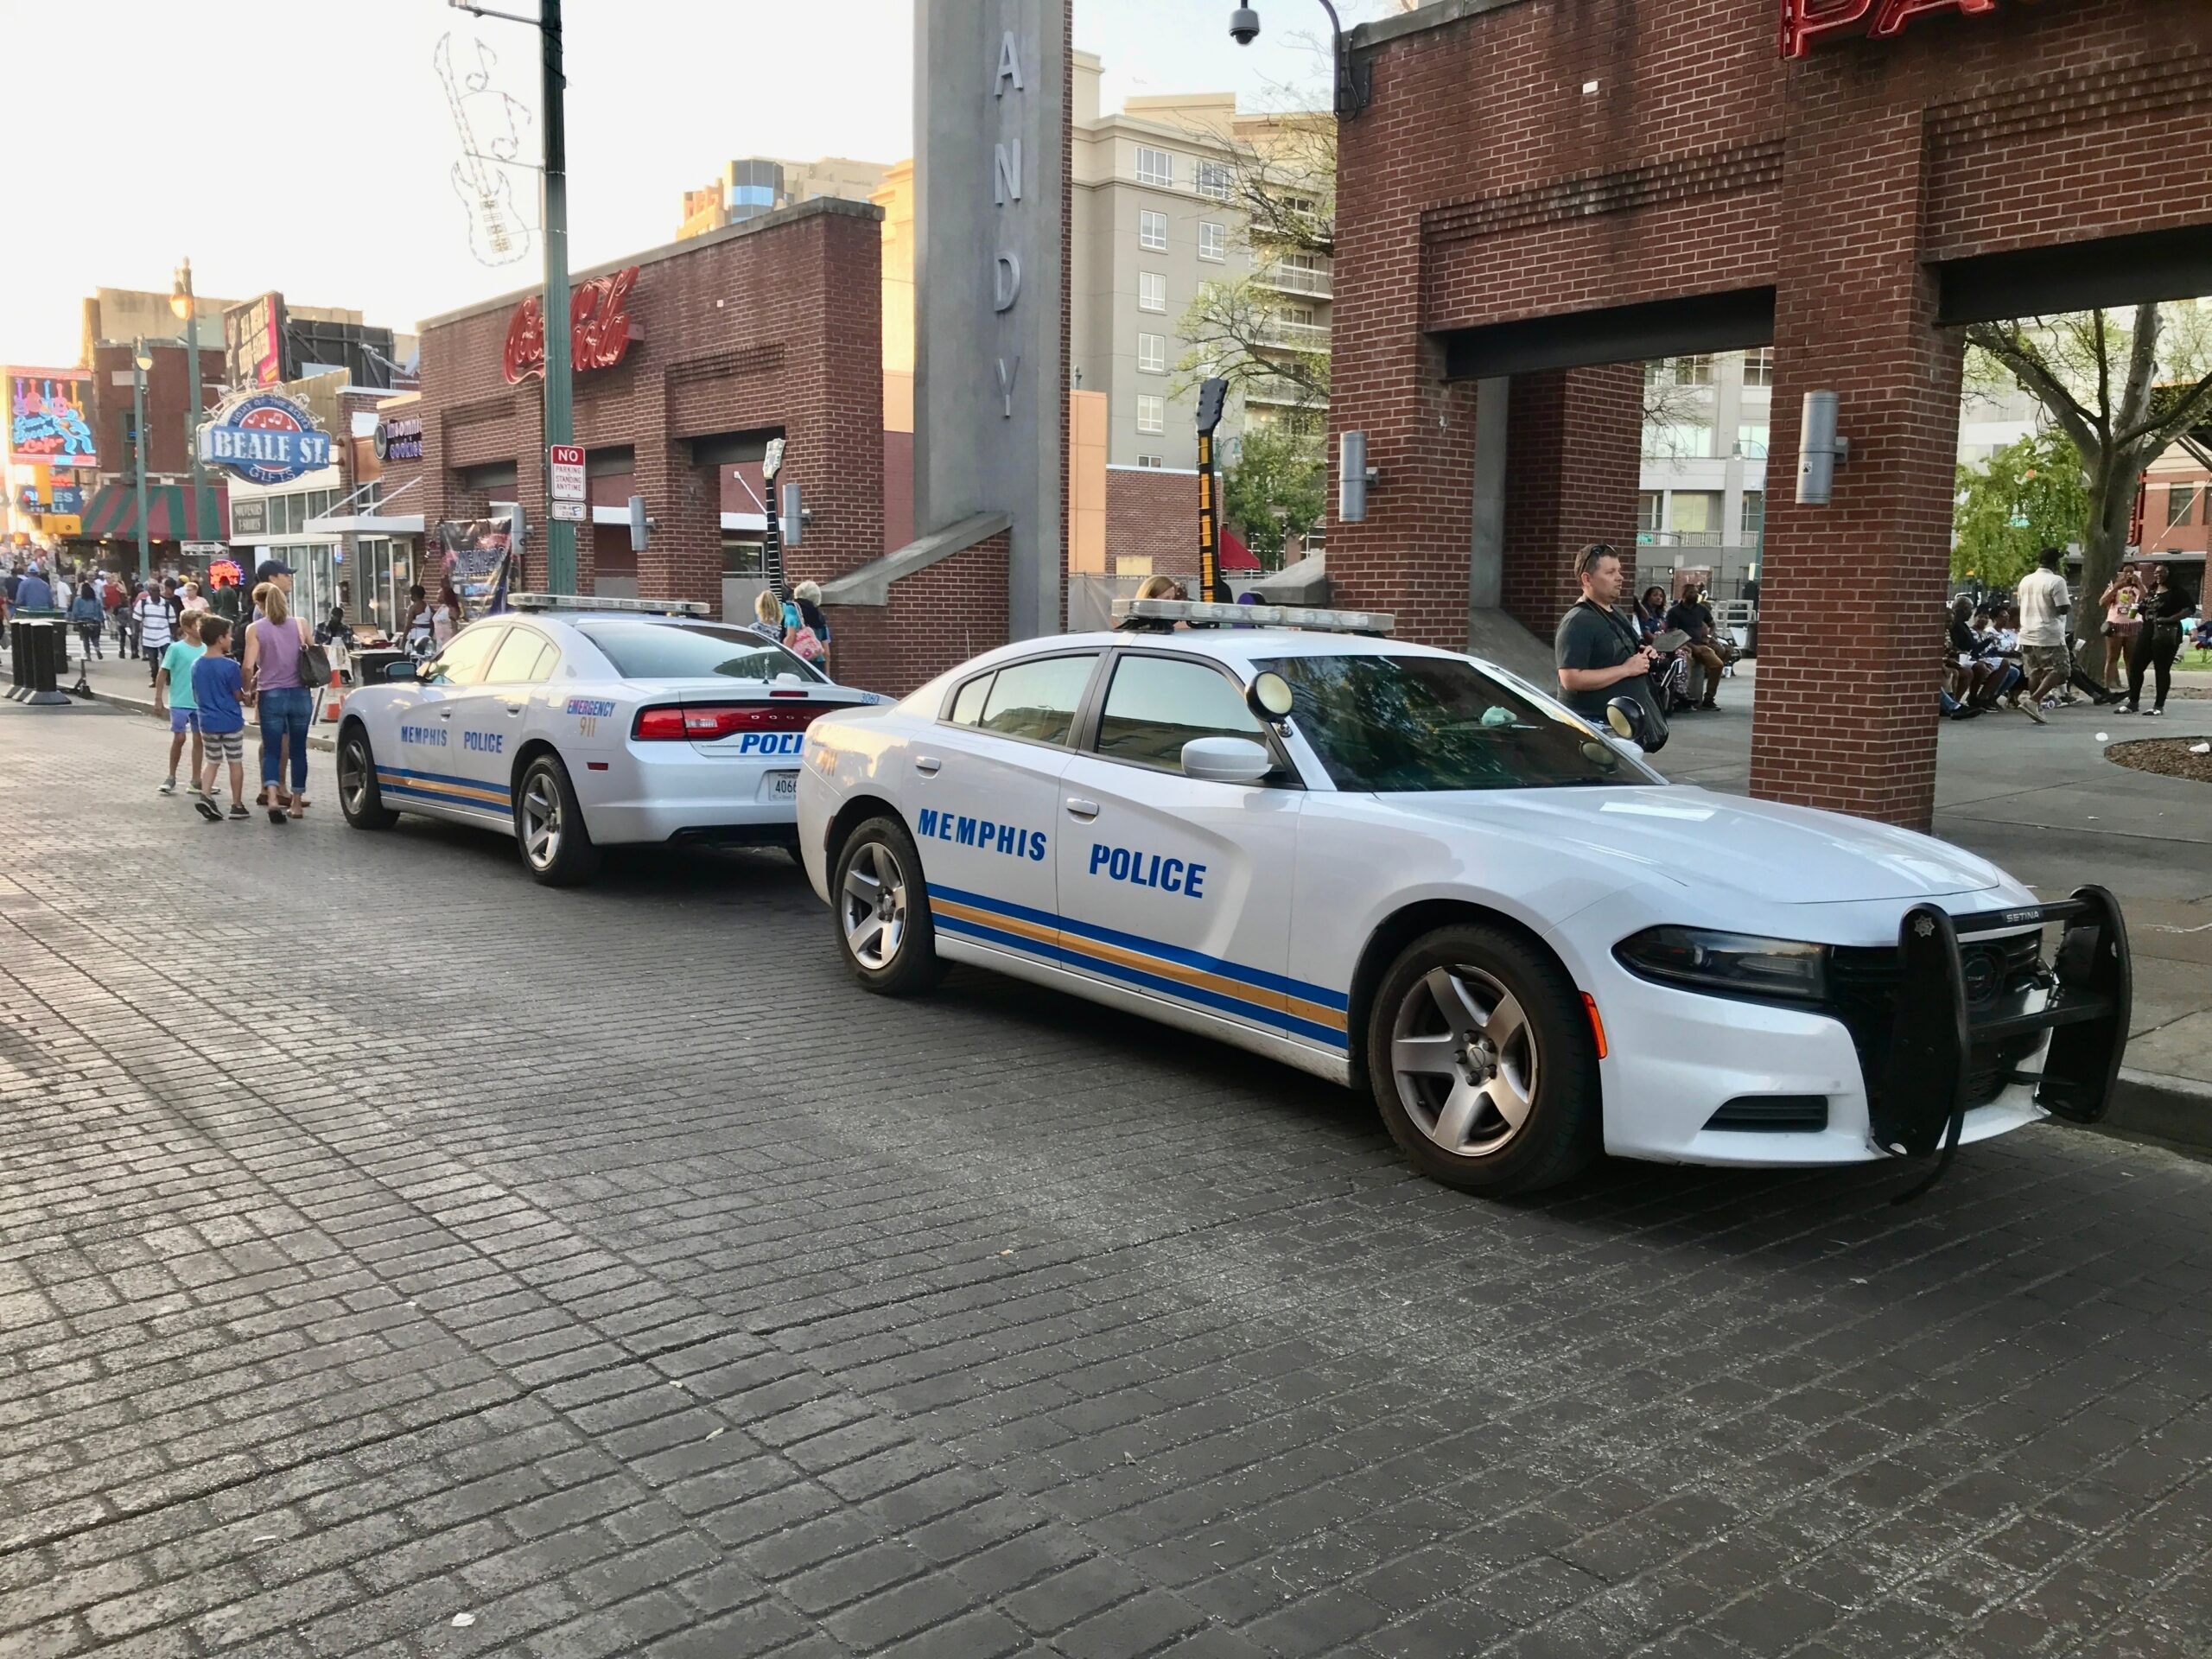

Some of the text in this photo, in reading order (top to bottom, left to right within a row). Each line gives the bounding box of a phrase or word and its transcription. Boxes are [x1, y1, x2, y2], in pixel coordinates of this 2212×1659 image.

[233, 401, 252, 423] HOME
[270, 398, 287, 409] THE
[213, 430, 328, 464] BEALE ST.
[557, 448, 579, 462] NO
[249, 467, 296, 482] GIFTS
[555, 465, 582, 474] PARKING
[555, 475, 582, 485] STANDING
[556, 483, 582, 492] ANYTIME
[860, 693, 880, 704] 3060
[567, 699, 615, 717] EMERGENCY
[580, 716, 595, 737] 911
[401, 725, 503, 753] MEMPHIS POLICE
[740, 734, 804, 754] POLI
[917, 808, 1207, 899] MEMPHIS POLICE
[2005, 911, 2039, 923] SETINA
